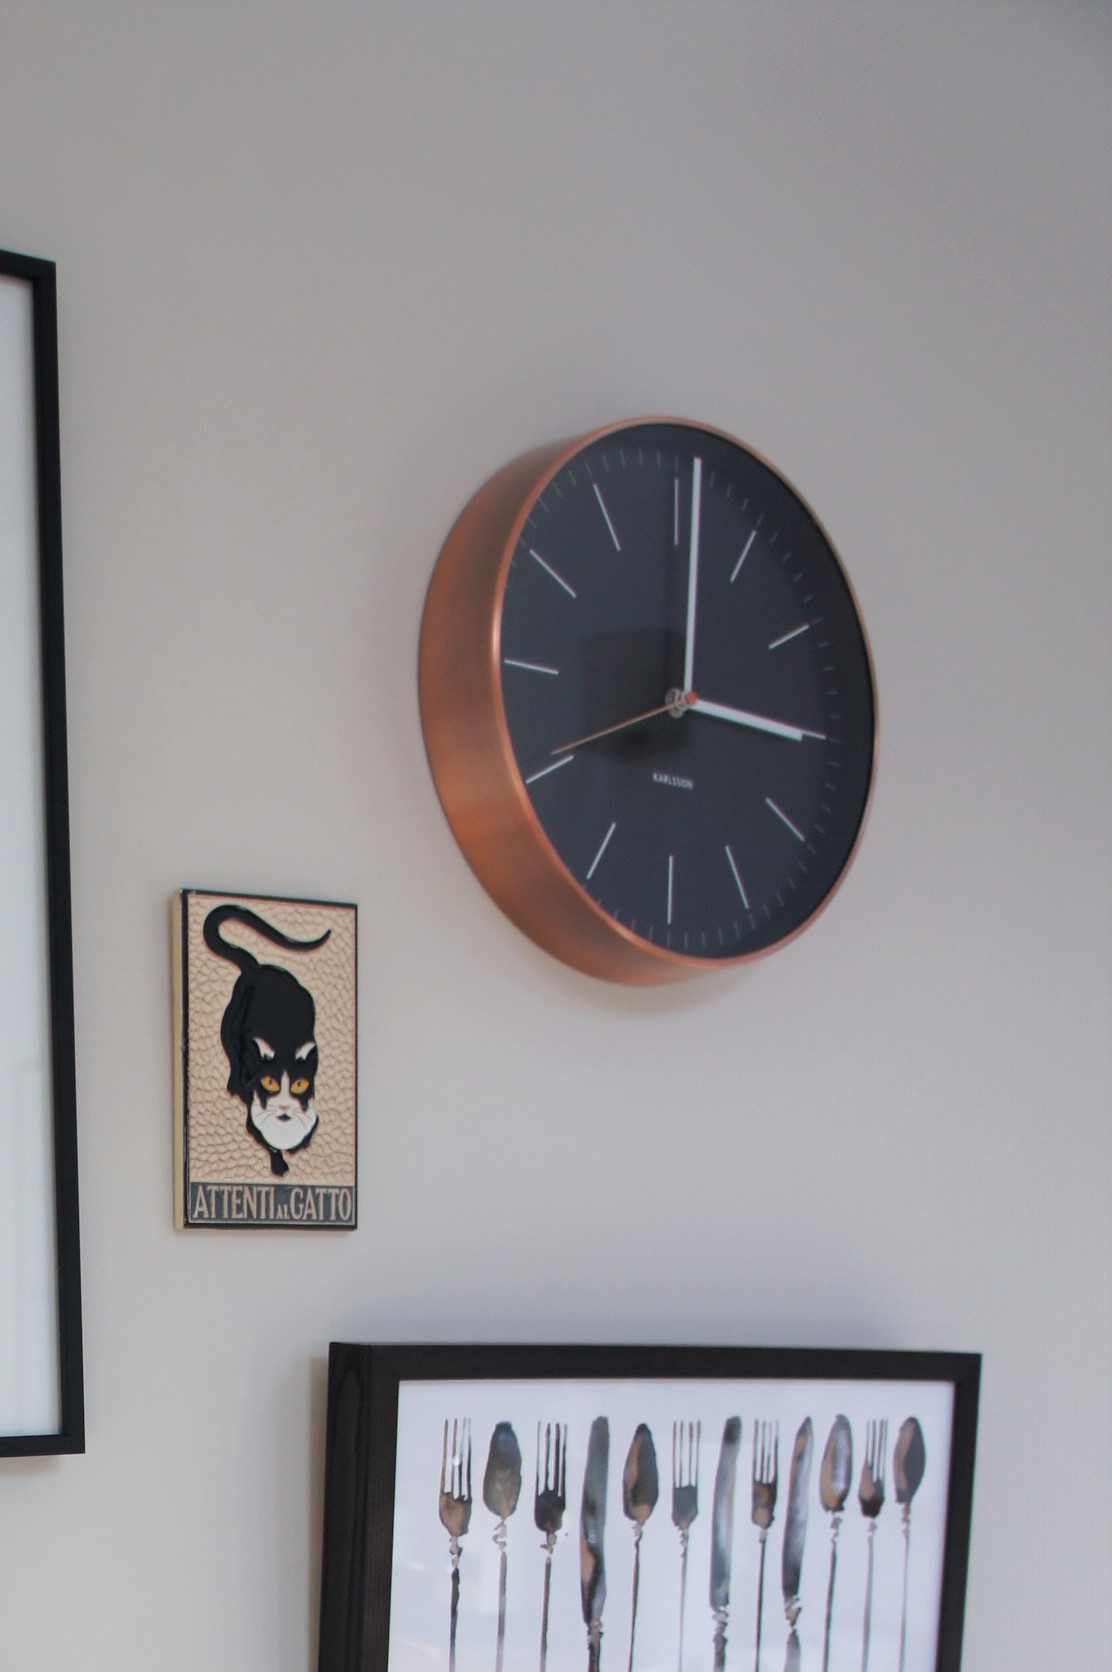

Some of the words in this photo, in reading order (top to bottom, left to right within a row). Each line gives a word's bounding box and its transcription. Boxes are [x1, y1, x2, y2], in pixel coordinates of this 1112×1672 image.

[192, 1184, 275, 1220] ATTENTI
[276, 1204, 289, 1220] AL
[289, 1187, 352, 1221] GATTO
